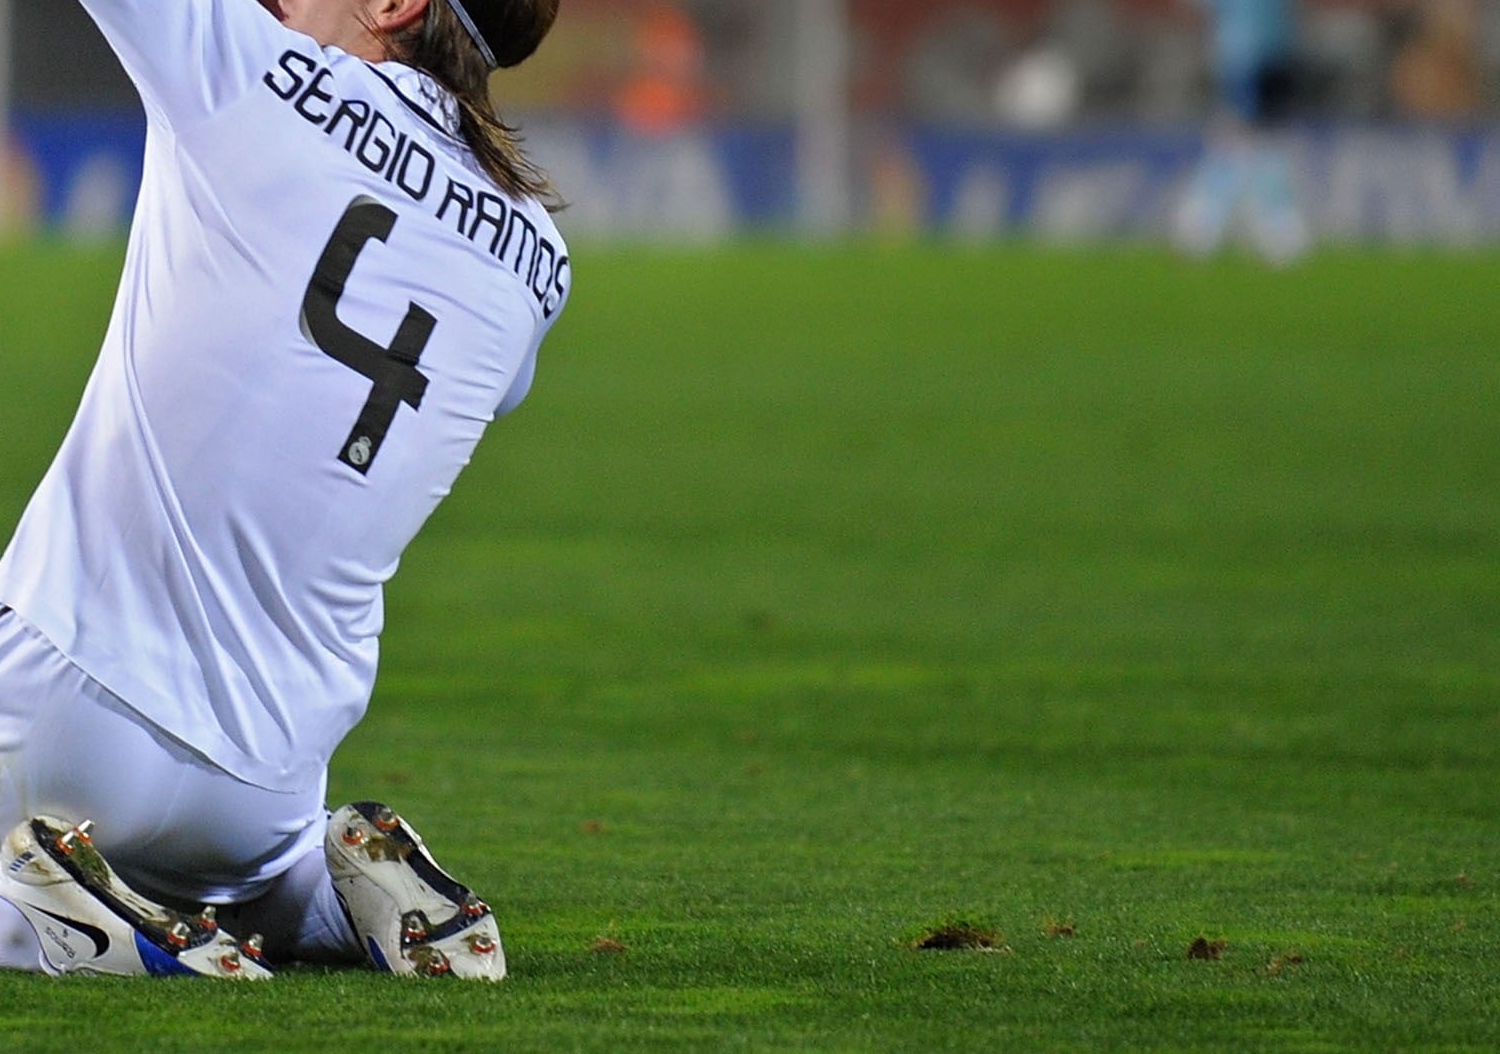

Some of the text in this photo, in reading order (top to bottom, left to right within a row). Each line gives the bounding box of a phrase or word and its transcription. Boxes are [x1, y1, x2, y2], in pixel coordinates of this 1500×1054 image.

[263, 49, 435, 201] SERGIO
[436, 177, 569, 319] RAMOS
[299, 193, 438, 476] 4
